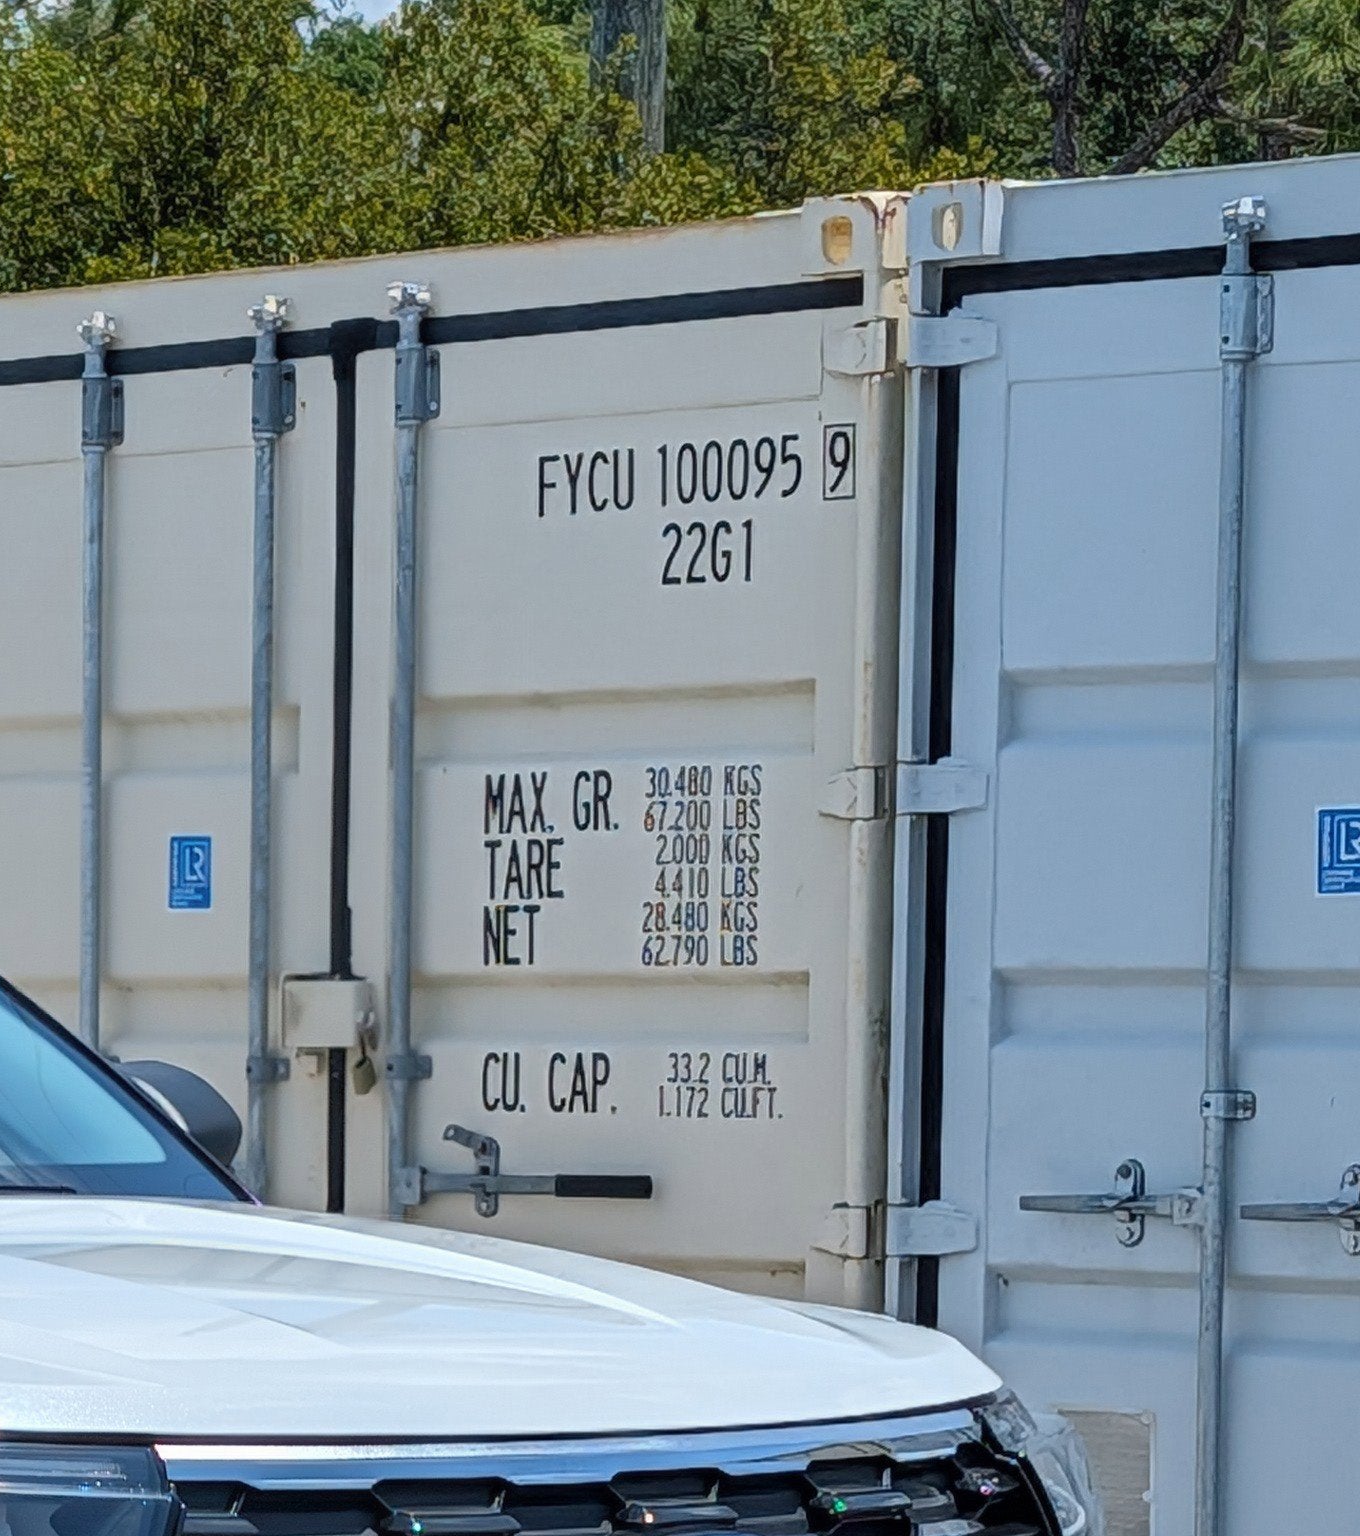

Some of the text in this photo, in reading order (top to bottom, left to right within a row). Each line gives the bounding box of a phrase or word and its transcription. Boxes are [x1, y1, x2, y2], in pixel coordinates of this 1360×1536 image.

[537, 428, 852, 518] FYCU 100095 9
[660, 517, 755, 586] 22G1
[572, 769, 620, 832] GR.
[644, 765, 712, 798] 30.480
[723, 764, 762, 797] KGS
[643, 798, 761, 832] 67.200 LBS
[483, 837, 565, 900] TARE
[721, 833, 761, 865] KGS
[654, 866, 760, 899] 4.410 LBS
[483, 900, 759, 967] NET 28.480 KGS
[641, 934, 759, 967] 62.790 LBS
[481, 1051, 526, 1113] CU.
[548, 1051, 618, 1115] CAP.
[666, 1051, 711, 1085] 33.2
[658, 1085, 710, 1118] 1.172
